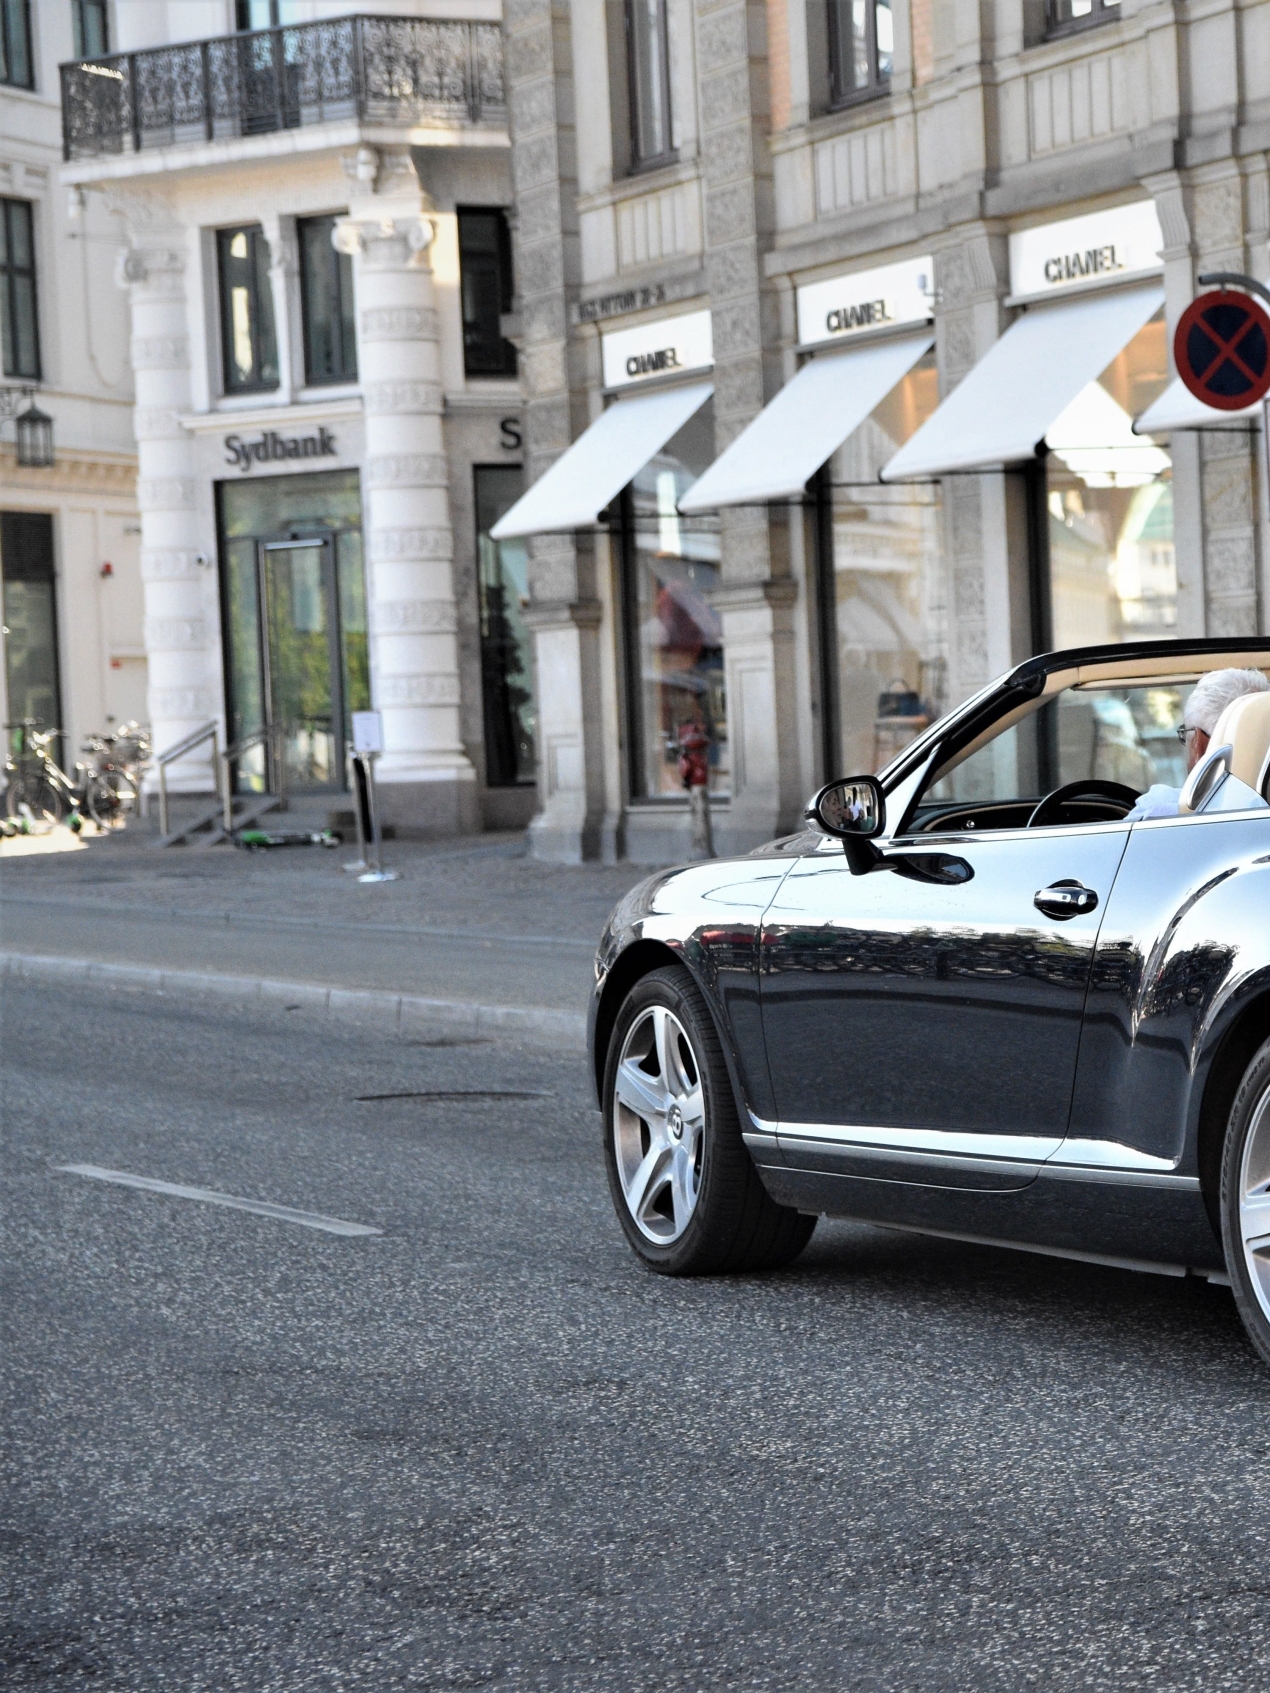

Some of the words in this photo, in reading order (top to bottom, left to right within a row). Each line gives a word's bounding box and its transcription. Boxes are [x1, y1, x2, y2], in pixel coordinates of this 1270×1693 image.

[1044, 245, 1124, 283] CHANEL
[826, 299, 893, 333] CHANEL
[626, 348, 682, 376] CHANEL
[224, 427, 337, 471] Sydbank
[500, 417, 522, 450] S
